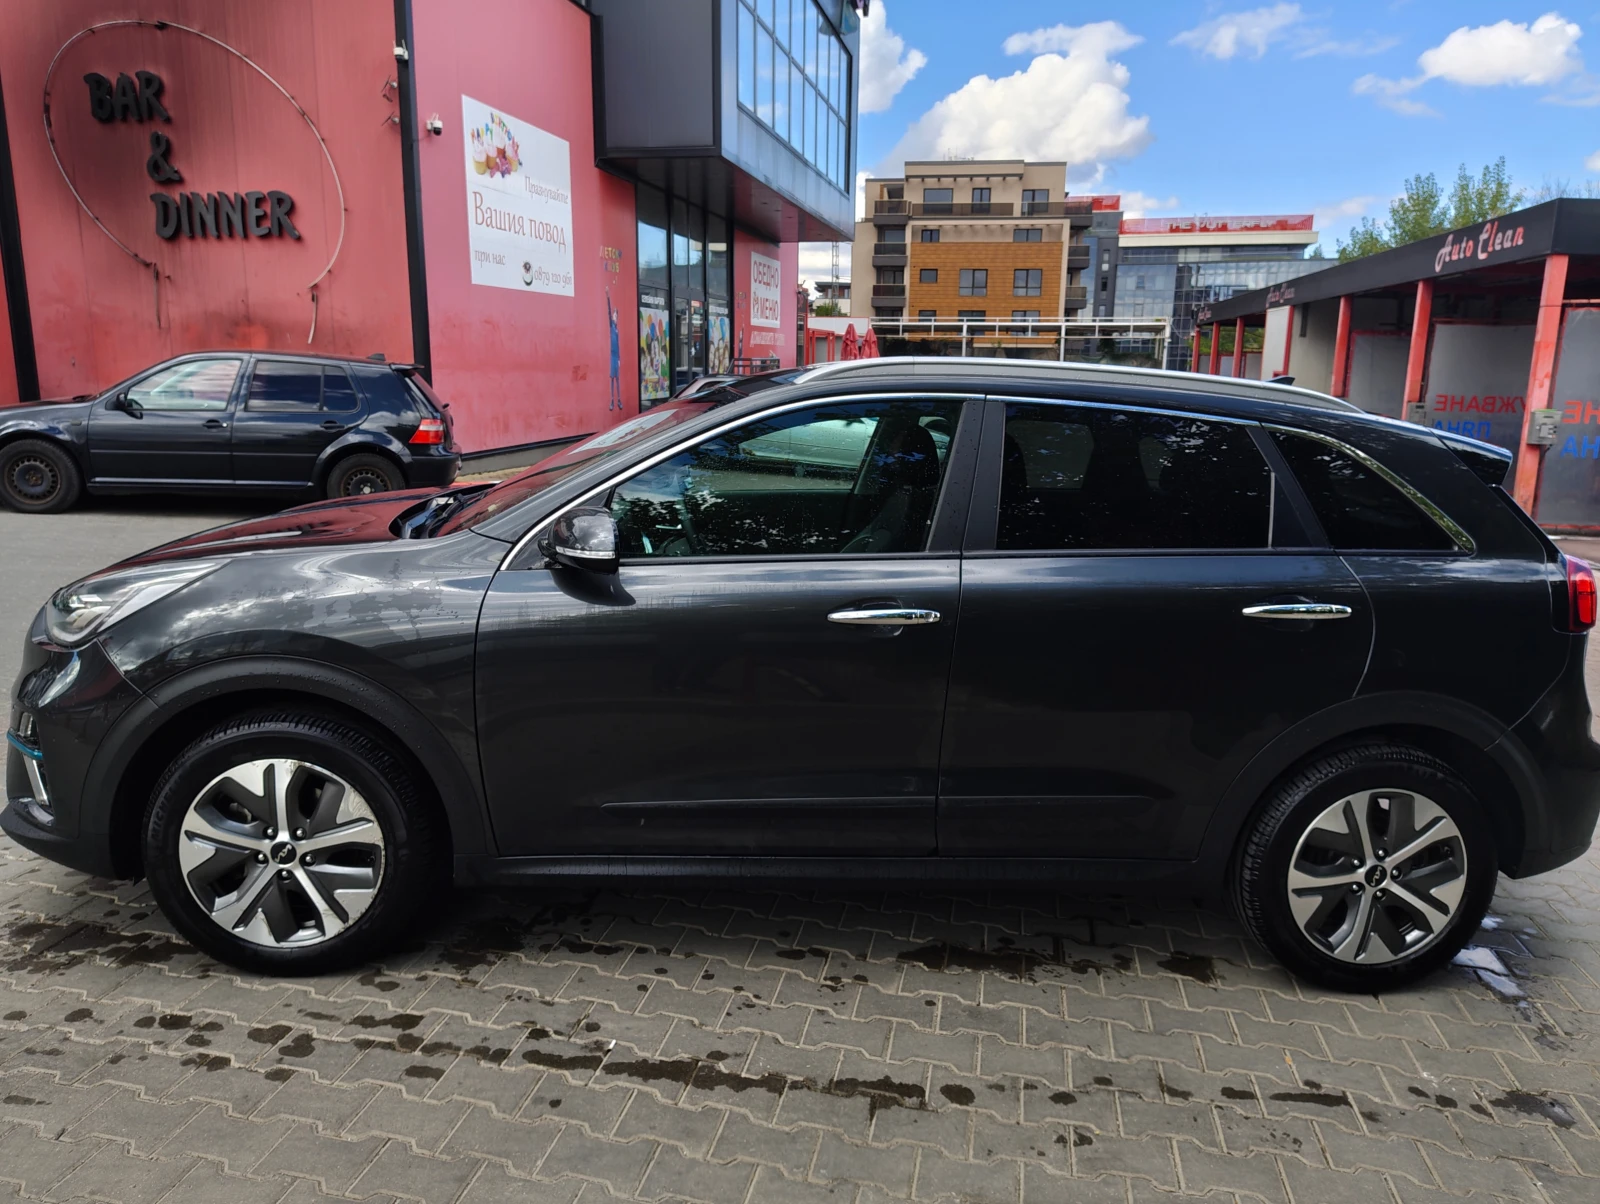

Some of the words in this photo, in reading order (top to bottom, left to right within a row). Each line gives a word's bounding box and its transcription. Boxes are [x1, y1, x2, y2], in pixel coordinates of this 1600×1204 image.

[84, 70, 172, 123] BAR
[146, 131, 183, 182] &
[150, 190, 302, 241] DINNER
[472, 191, 526, 236] Вашия
[528, 218, 567, 255] повод
[474, 250, 491, 268] при
[491, 253, 506, 266] нас
[1435, 233, 1474, 273] Auto
[1477, 220, 1525, 260] Clean
[753, 260, 780, 291] ОБЕДНО
[760, 297, 780, 322] МЕНЮ
